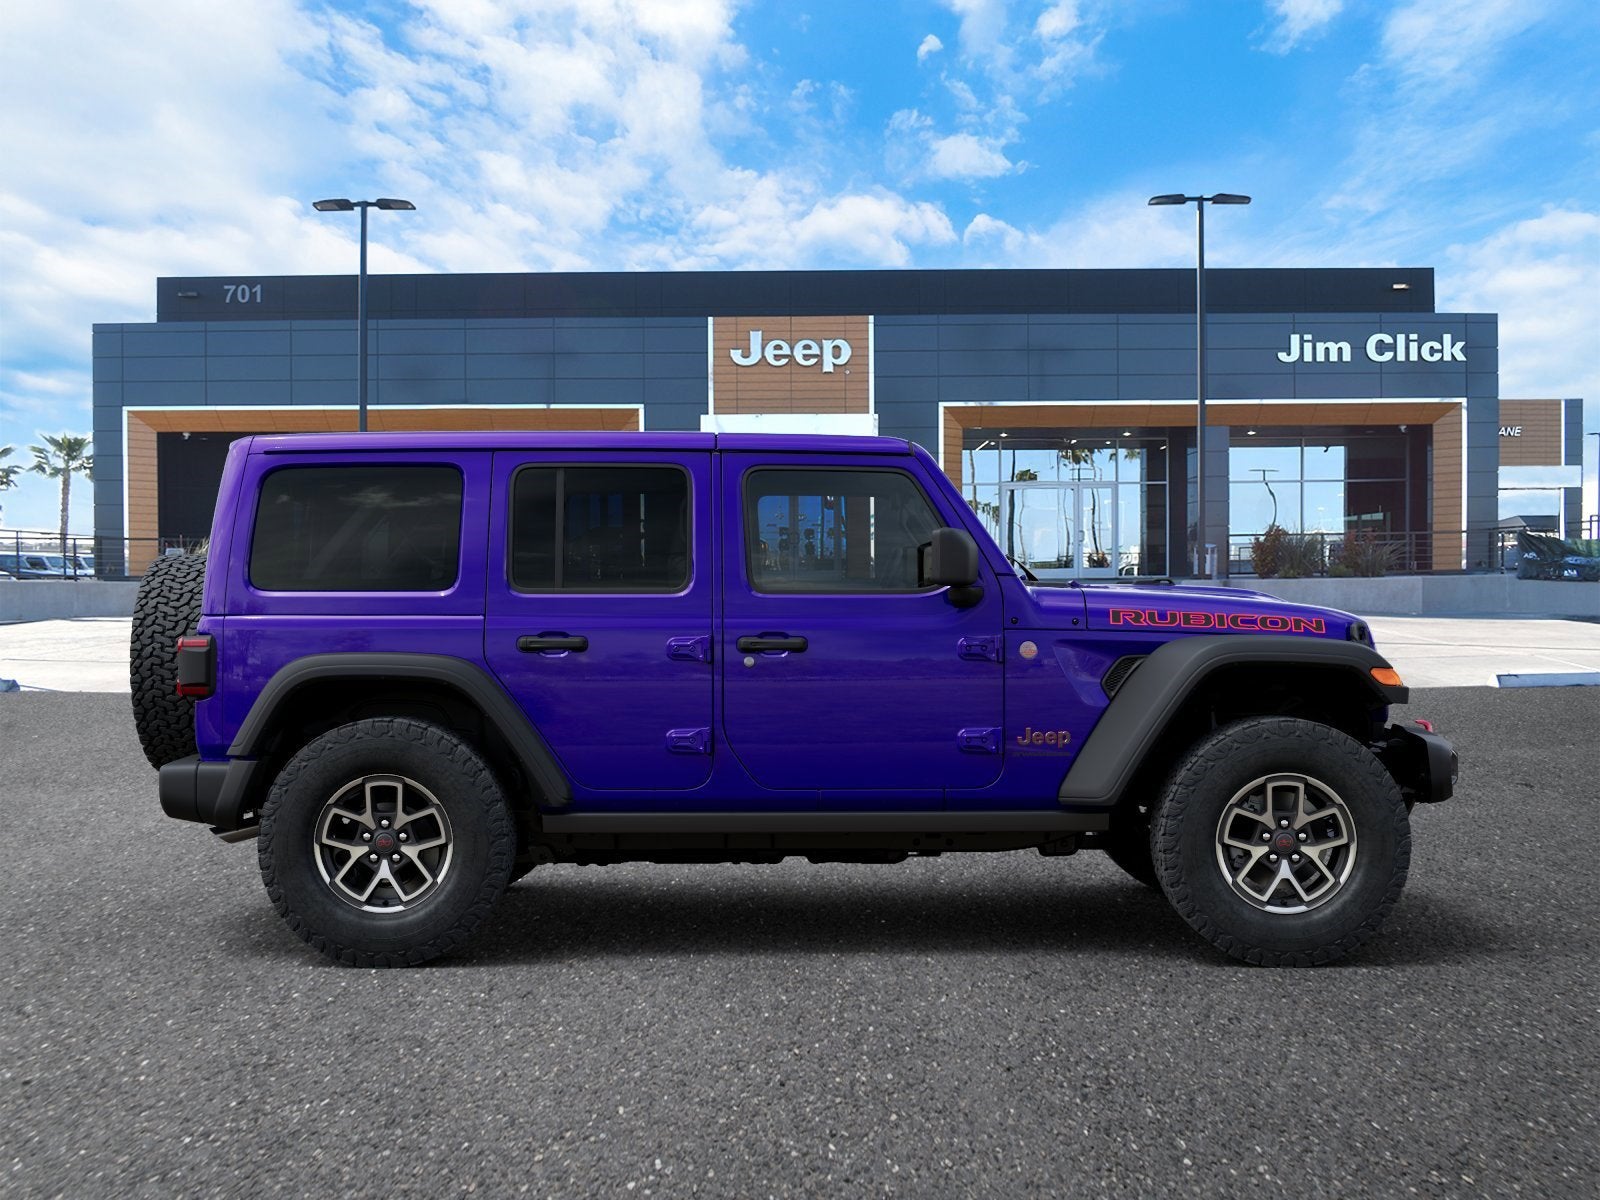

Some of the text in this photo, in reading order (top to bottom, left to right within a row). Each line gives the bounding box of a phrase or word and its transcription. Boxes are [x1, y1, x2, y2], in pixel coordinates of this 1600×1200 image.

[223, 284, 262, 304] 701
[729, 330, 852, 373] Jeep
[1277, 332, 1467, 363] Jim Click
[1109, 608, 1326, 634] RUBICON
[1017, 727, 1071, 748] Jeep
